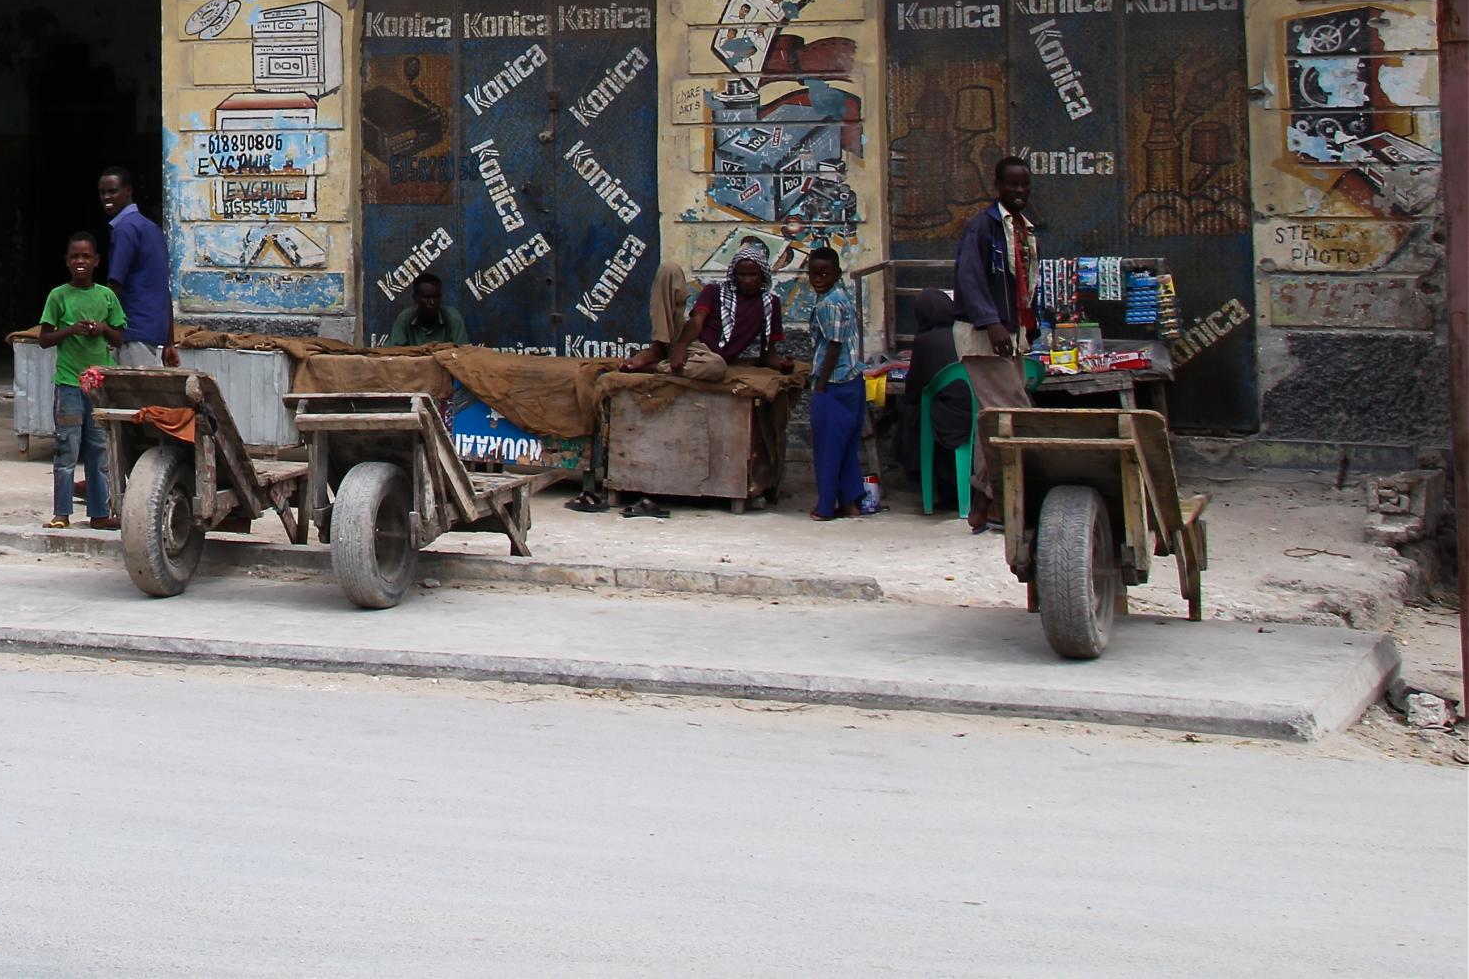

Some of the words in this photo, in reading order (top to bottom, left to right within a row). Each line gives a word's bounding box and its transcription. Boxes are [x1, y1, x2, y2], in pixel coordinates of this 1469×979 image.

[365, 11, 452, 38] Konica
[463, 10, 552, 39] Konica
[558, 3, 651, 32] Konica
[897, 0, 1001, 30] Konica
[464, 43, 549, 117] Konica
[569, 46, 650, 128] Konica
[1030, 18, 1092, 121] Konica
[209, 134, 282, 154] 618890806
[470, 138, 525, 233] Konica
[563, 140, 642, 225] Konica
[376, 227, 454, 301] Konica
[465, 233, 551, 301] Konica
[576, 234, 647, 322] Konica
[1171, 298, 1251, 368] onica
